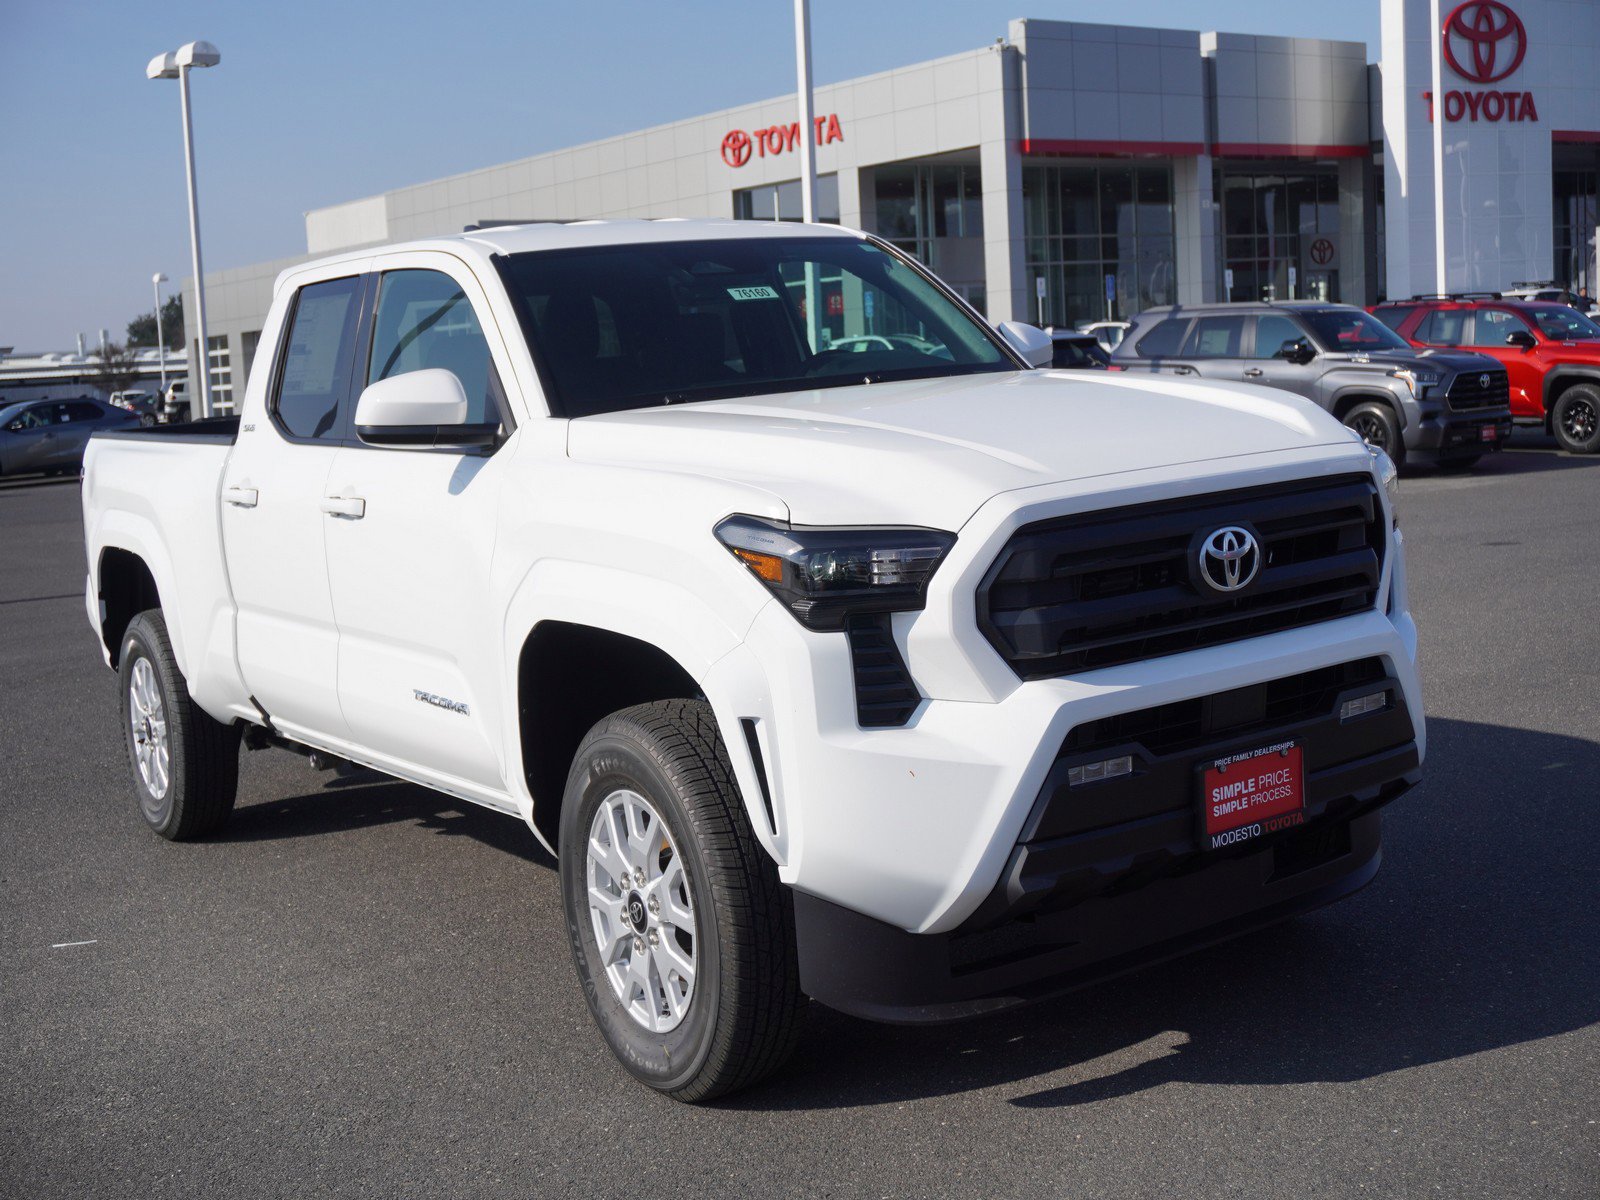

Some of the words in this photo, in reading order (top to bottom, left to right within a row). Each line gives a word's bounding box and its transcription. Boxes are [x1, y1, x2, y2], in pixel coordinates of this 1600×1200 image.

[734, 287, 771, 299] 76160
[413, 688, 471, 717] TACOMA
[1214, 756, 1232, 768] PRICE
[1233, 750, 1254, 763] FAMILY
[1255, 740, 1295, 759] DEALERSHIPS
[1212, 777, 1256, 803] SIMPLE
[1258, 768, 1293, 790] PRICE.
[1213, 796, 1249, 818] SIMPLE
[1250, 785, 1294, 807] PROCESS.
[1212, 823, 1261, 849] MODESTO
[1263, 811, 1304, 833] TOYOTA
